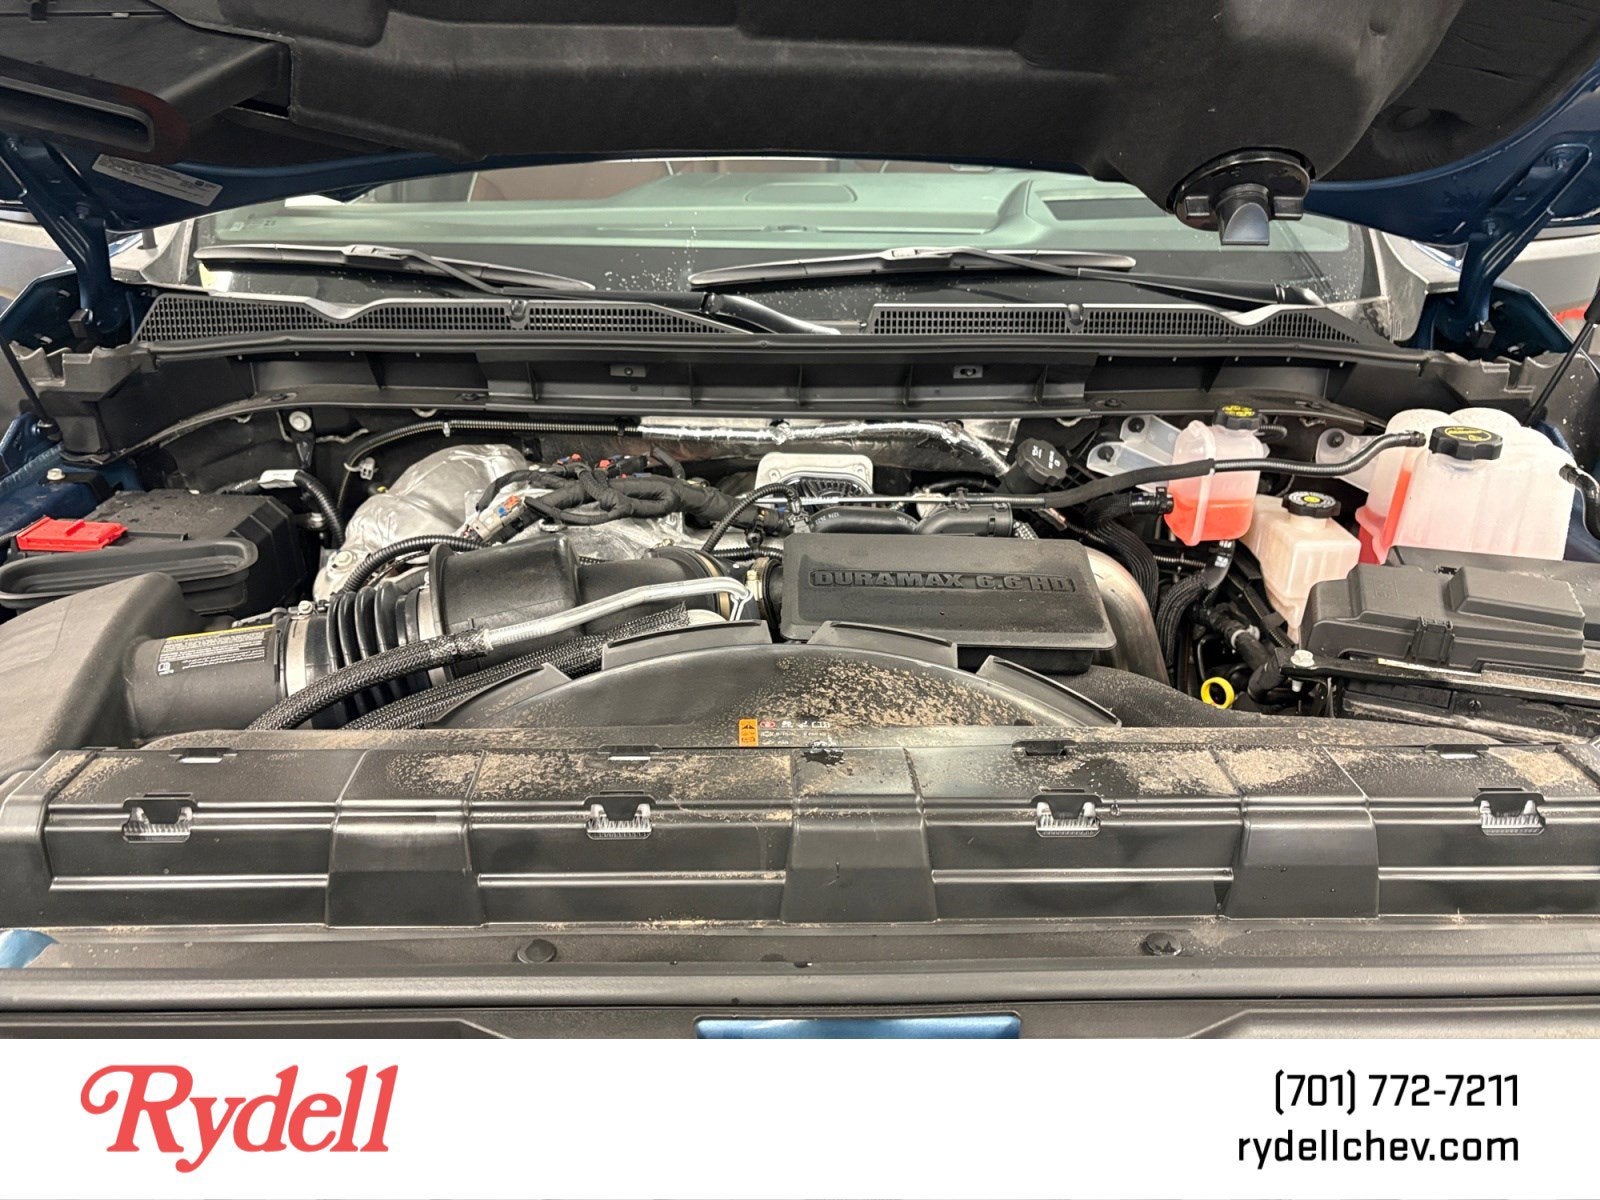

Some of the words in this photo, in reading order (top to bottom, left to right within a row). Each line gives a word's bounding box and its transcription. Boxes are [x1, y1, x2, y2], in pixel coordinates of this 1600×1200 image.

[813, 570, 963, 589] DURAMAX
[975, 574, 1023, 590] 6.6
[1031, 576, 1074, 593] HD
